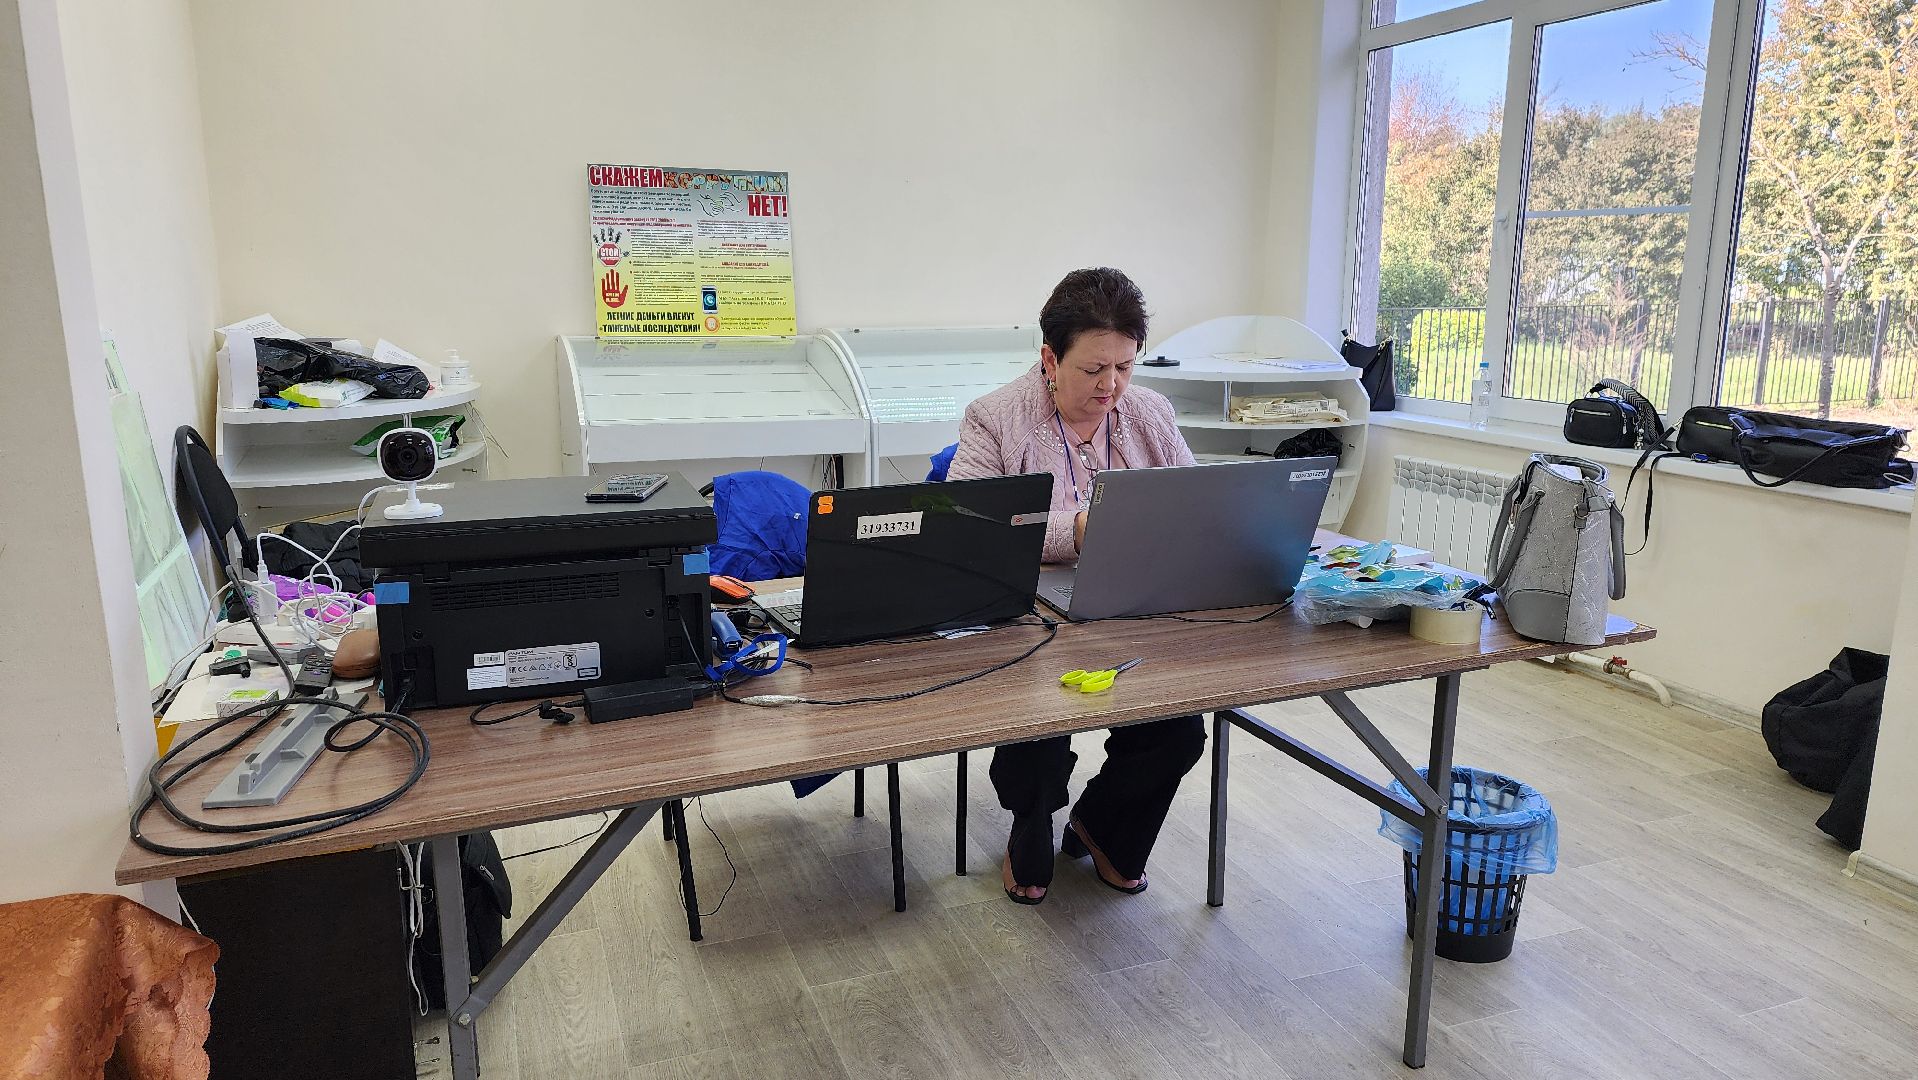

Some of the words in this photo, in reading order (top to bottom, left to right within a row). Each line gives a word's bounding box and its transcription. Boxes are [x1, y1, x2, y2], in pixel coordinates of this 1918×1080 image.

[589, 166, 662, 188] СКАЖЕМ
[747, 194, 788, 217] НЕТ!
[636, 312, 666, 322] ДЕНЬГИ
[667, 312, 695, 321] ВЛЕКУТ
[602, 324, 641, 333] ТЯЖЕЛЫЕ
[642, 324, 701, 334] ПОСЛЕДСТВИЯ!
[860, 521, 915, 535] 31933731
